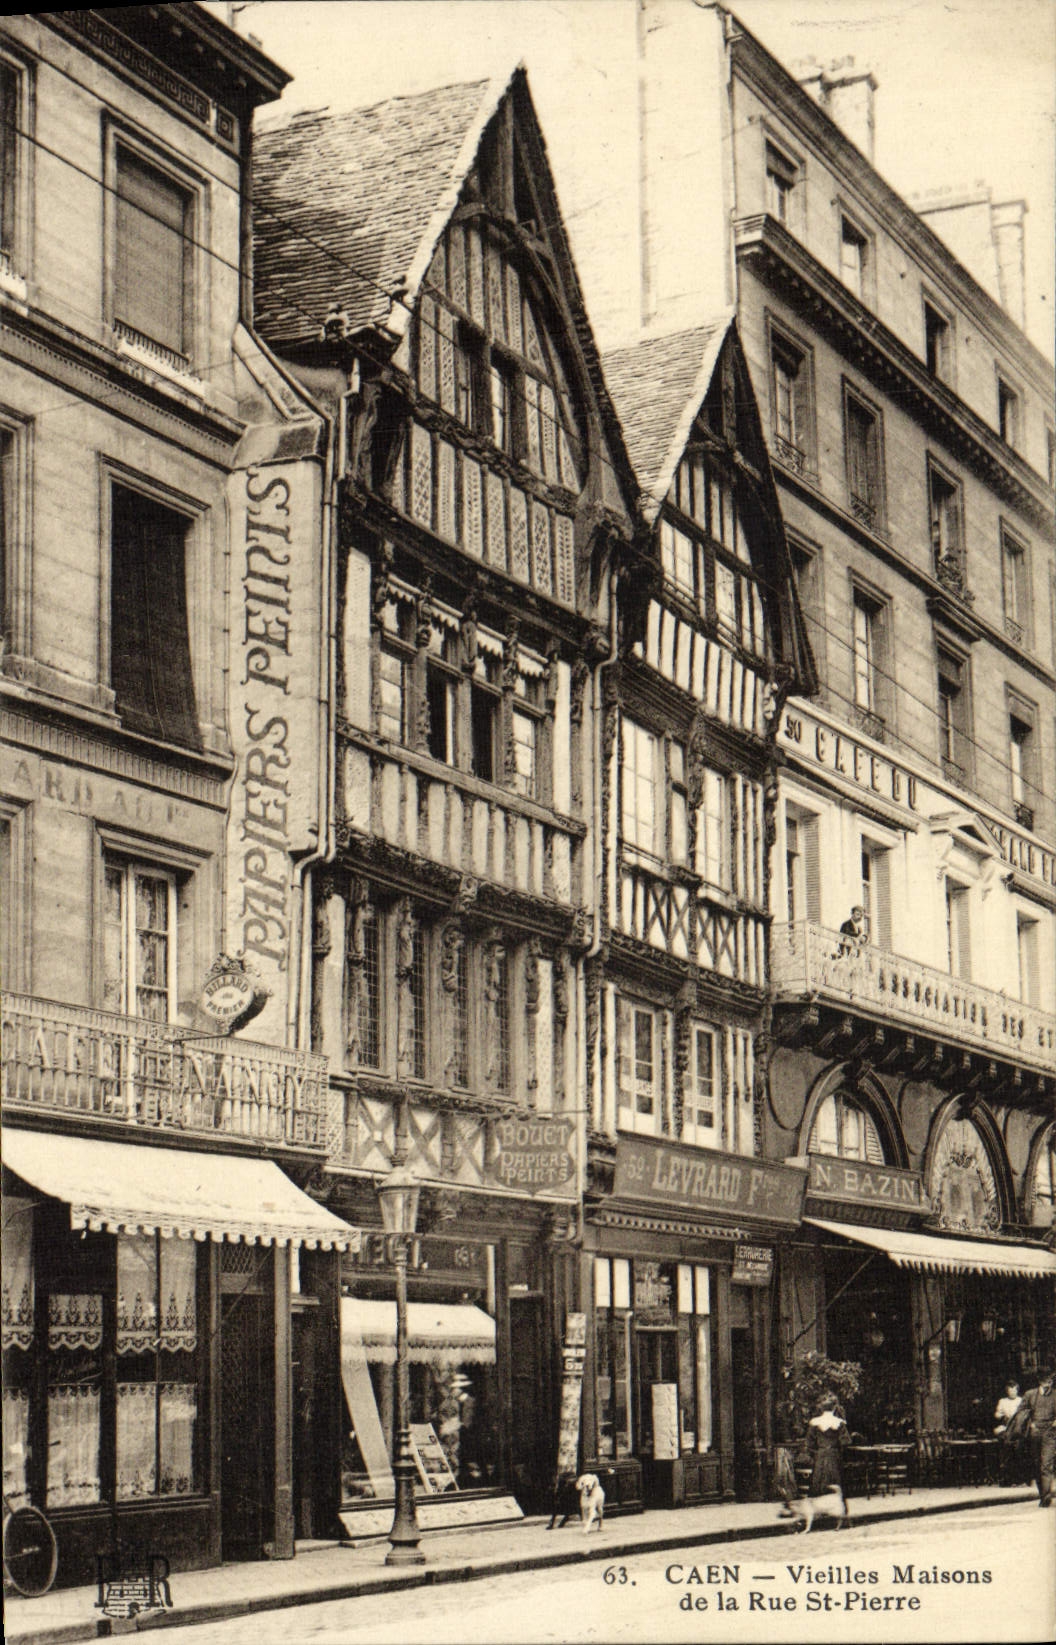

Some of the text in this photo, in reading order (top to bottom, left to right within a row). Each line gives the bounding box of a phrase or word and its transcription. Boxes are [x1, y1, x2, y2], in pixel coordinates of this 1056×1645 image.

[237, 469, 292, 972] PAPIERS PEINTS
[815, 726, 880, 792] CAFE
[891, 766, 917, 811] DU
[206, 975, 249, 997] BILLARD
[878, 966, 988, 1027] ASSOCIATION
[1002, 1012, 1024, 1040] DES
[206, 1000, 246, 1016] PREMIER
[501, 1122, 569, 1147] BOUET
[651, 1148, 742, 1203] LEVRARD
[844, 1169, 917, 1201] BAZIN
